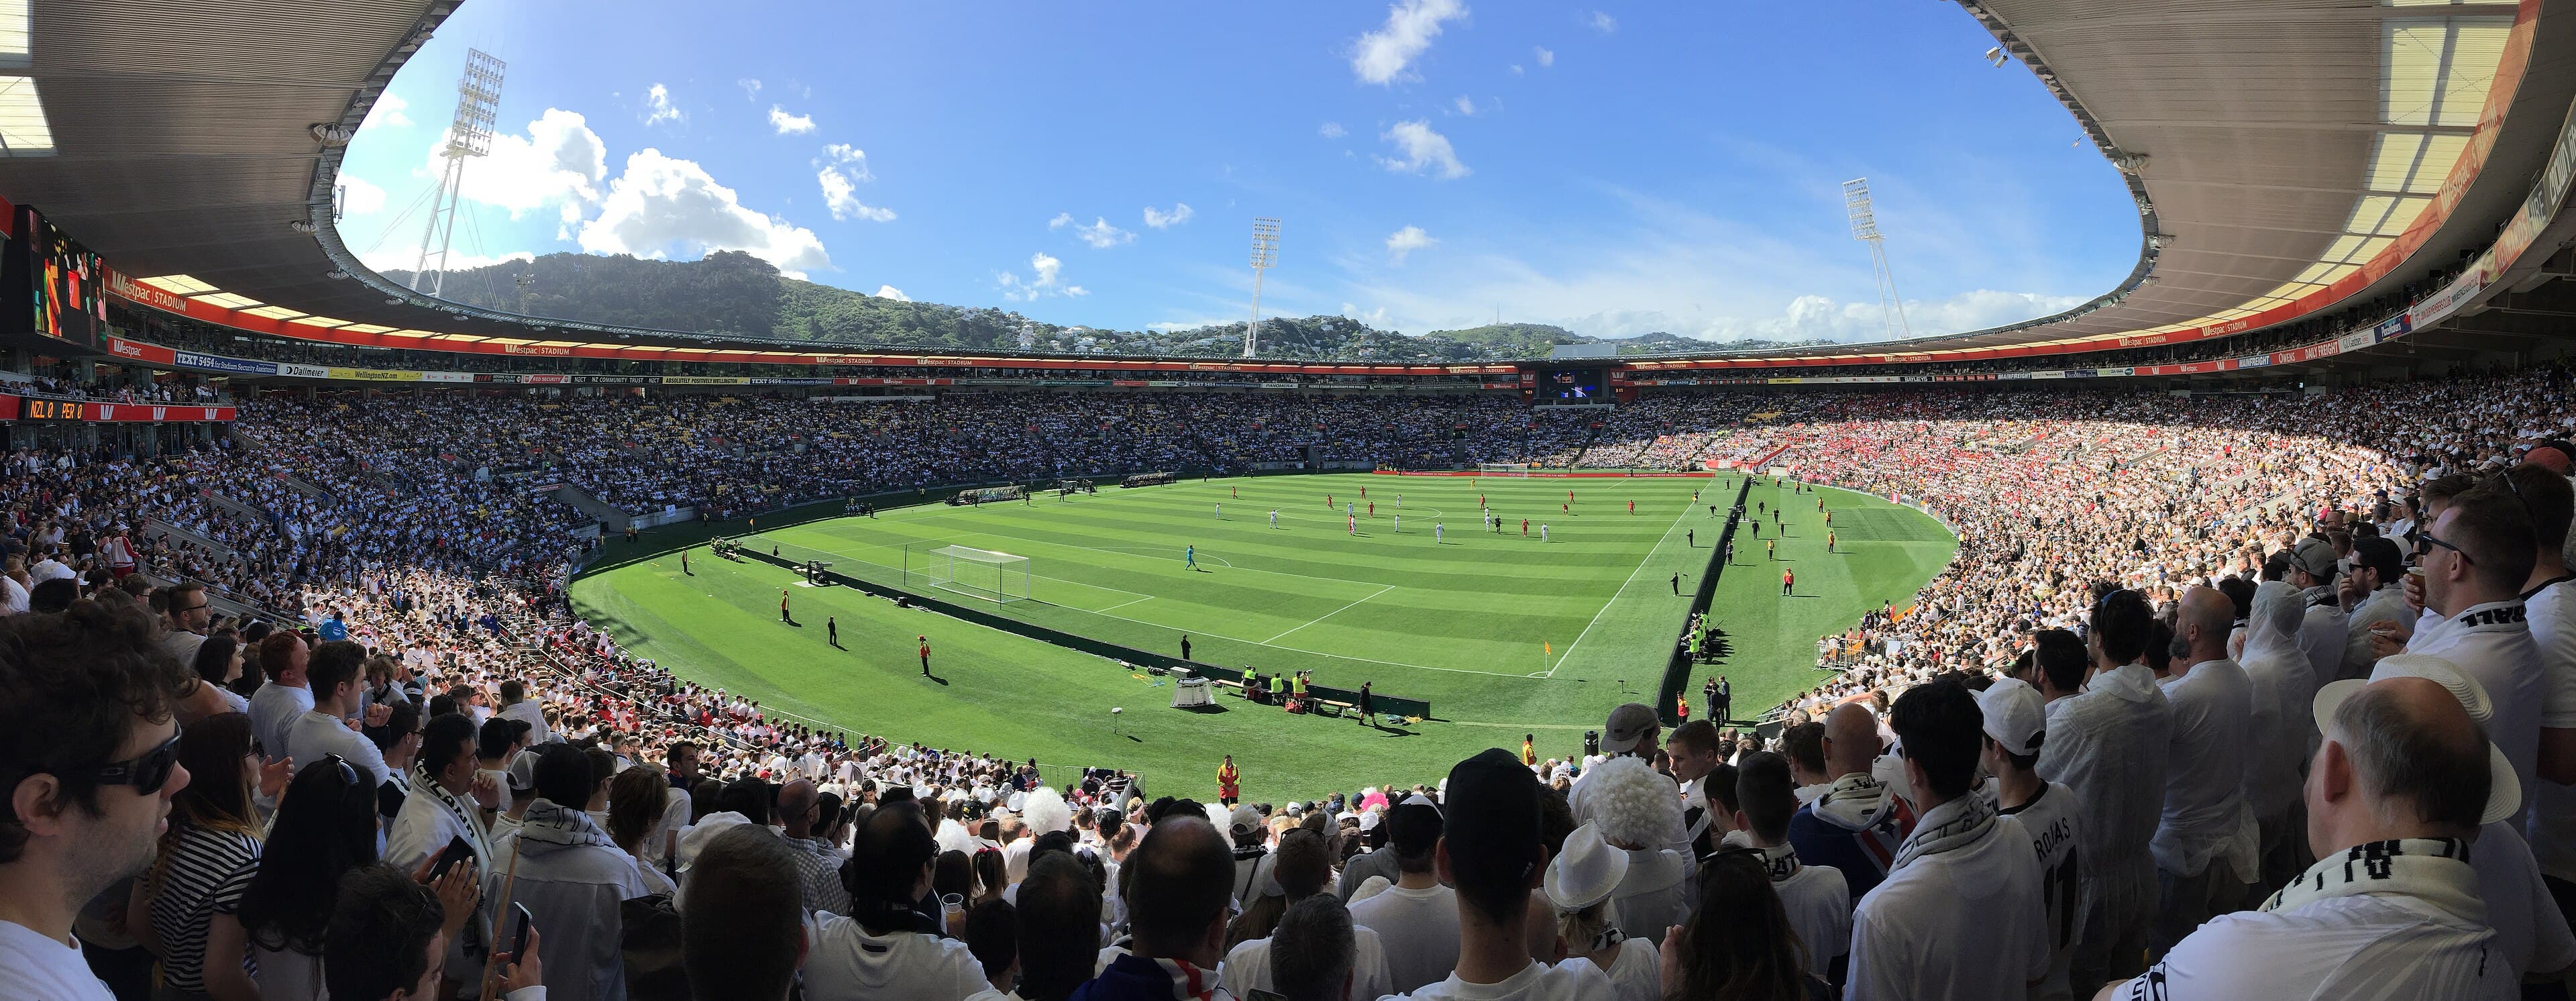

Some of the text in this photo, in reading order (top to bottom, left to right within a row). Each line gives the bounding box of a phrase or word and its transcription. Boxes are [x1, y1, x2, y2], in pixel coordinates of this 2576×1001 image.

[2439, 158, 2469, 213] Westpac
[2529, 190, 2546, 233] HIRE
[112, 270, 186, 312] Westpac STADIUM
[2202, 320, 2247, 336] Westpac STADIUM
[114, 339, 142, 357] Westpac
[2118, 335, 2166, 347] Westpac STADIUM
[504, 344, 537, 356] Westpac
[2279, 352, 2295, 363] OWENS
[2305, 343, 2338, 360] DAILY FREIGHT
[177, 353, 199, 366] TEXT
[199, 356, 215, 368] 5454
[221, 361, 237, 370] Stadium
[237, 364, 255, 373] Security
[2239, 355, 2269, 368] MAINFREIGHT
[30, 401, 54, 419] NZL 0
[61, 403, 83, 419] PER 0
[2033, 817, 2070, 862] ROJAS
